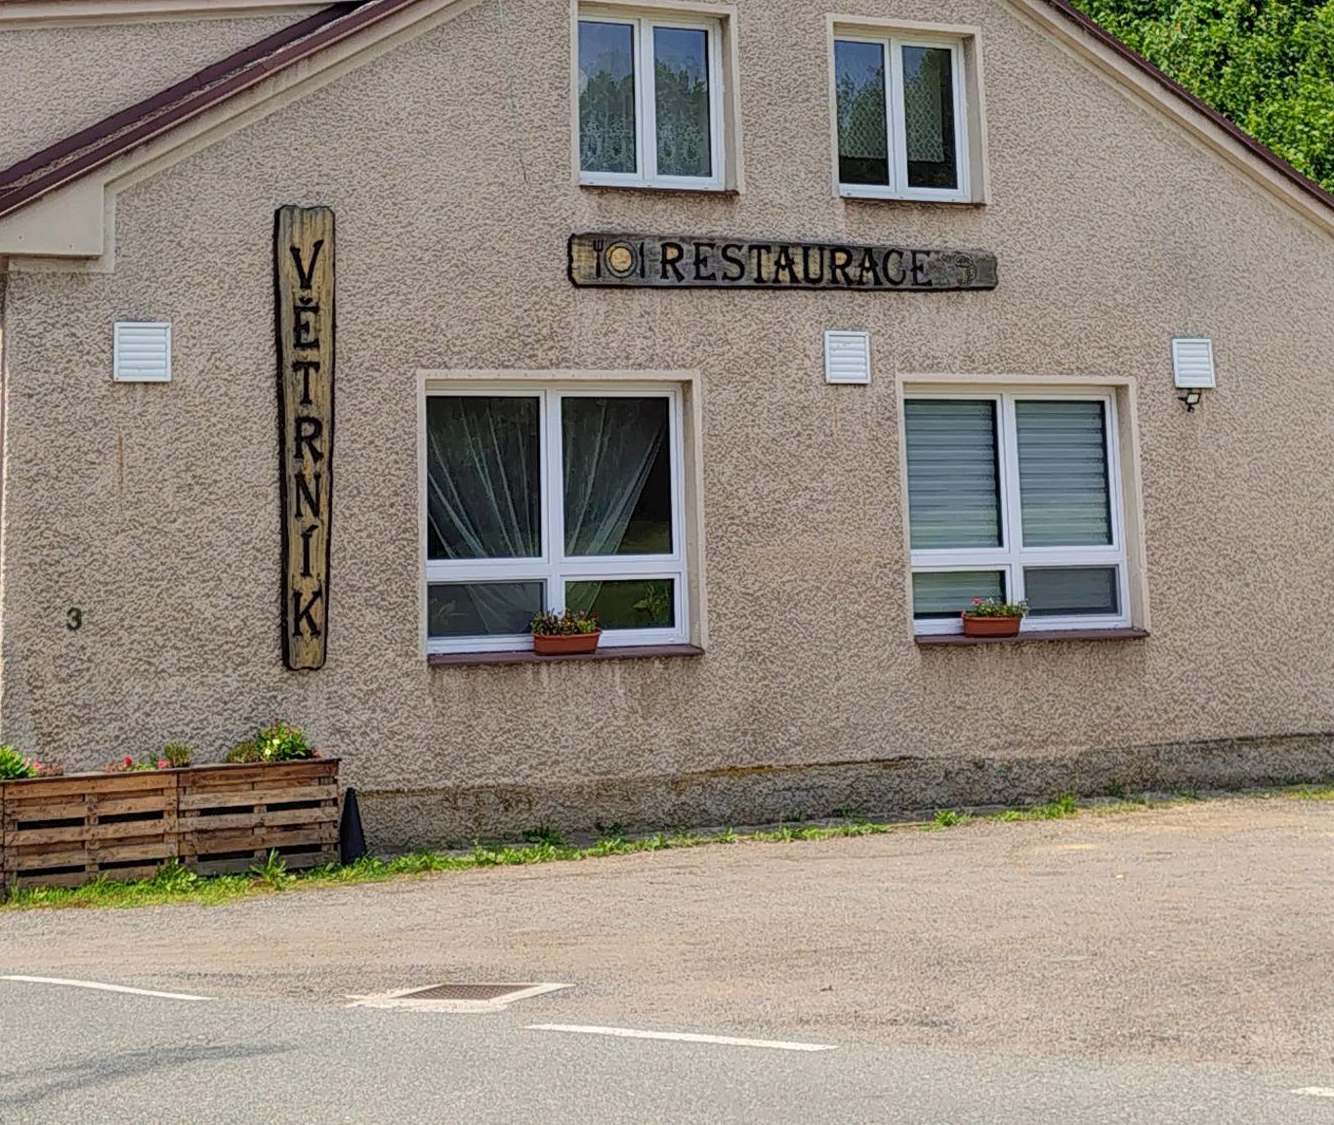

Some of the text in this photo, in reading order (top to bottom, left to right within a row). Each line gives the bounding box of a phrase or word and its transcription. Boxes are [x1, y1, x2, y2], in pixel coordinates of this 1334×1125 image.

[659, 242, 933, 287] RESTAURACE
[289, 240, 324, 637] VĚTRNÍK
[67, 607, 82, 631] 3
